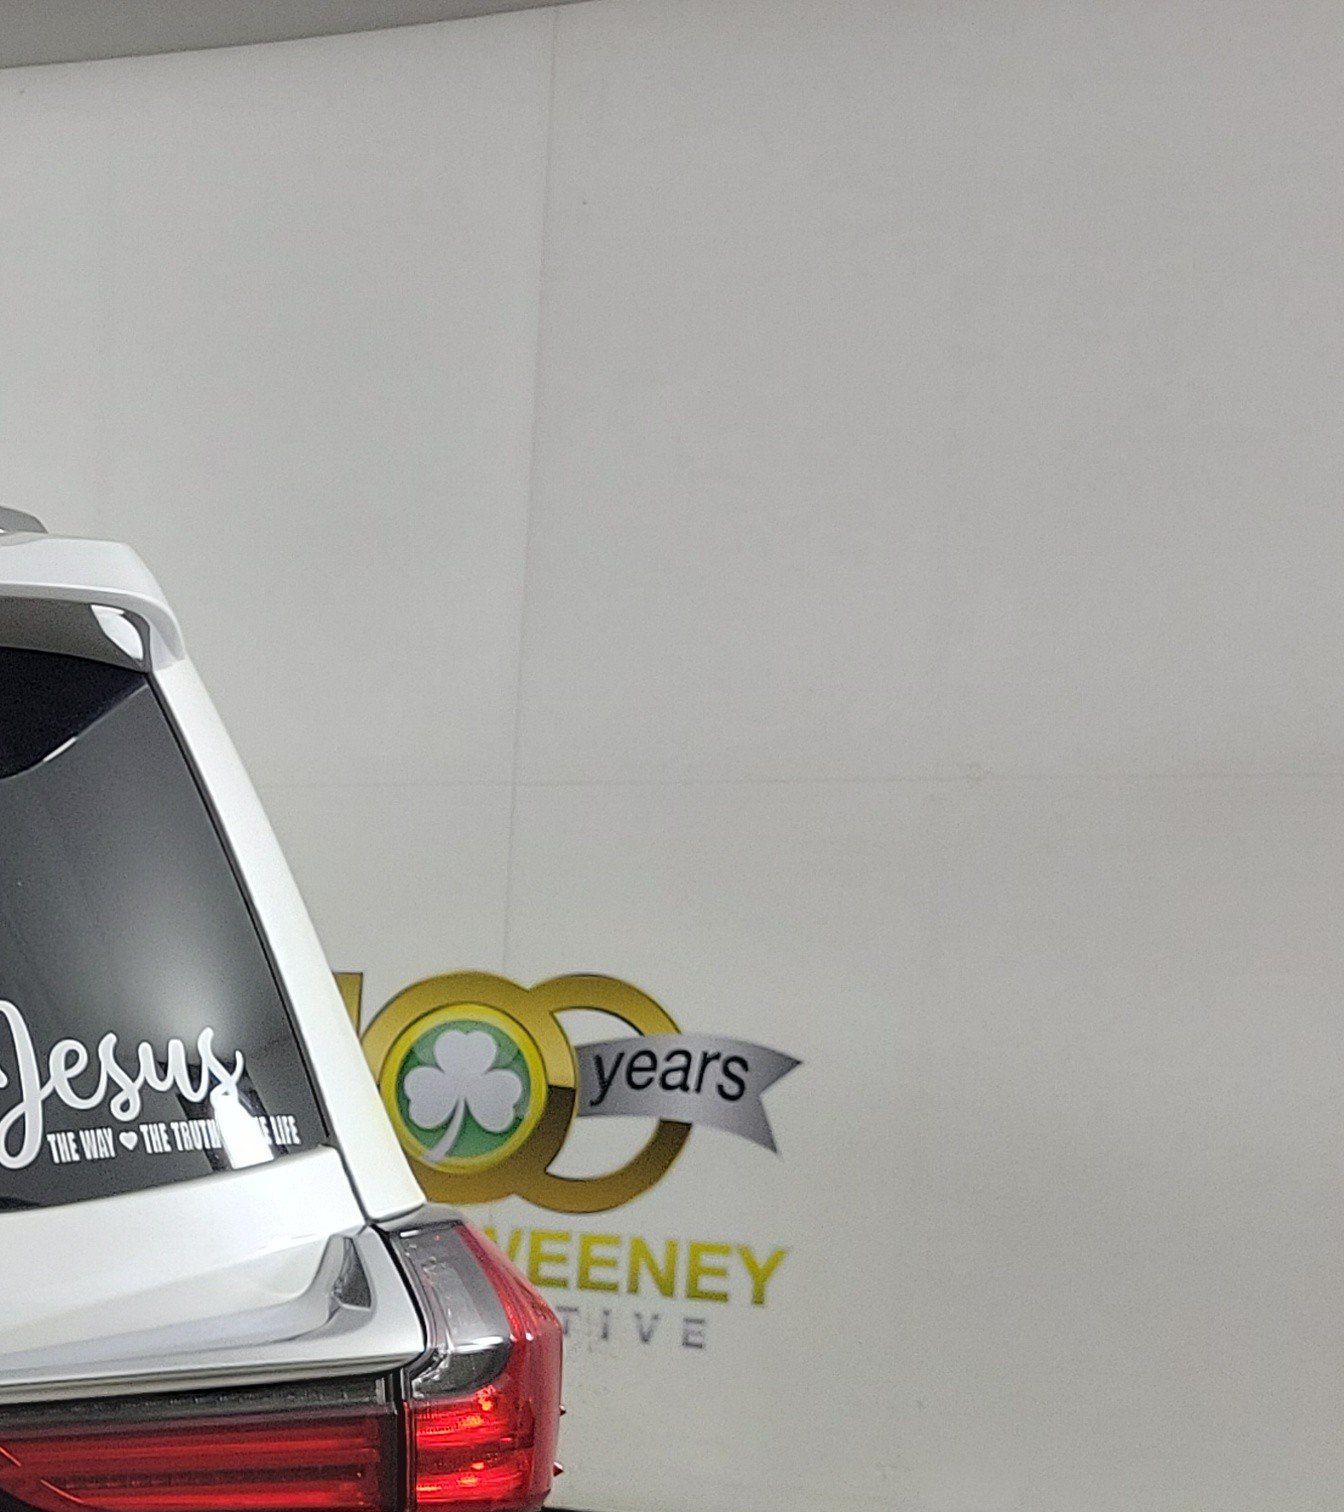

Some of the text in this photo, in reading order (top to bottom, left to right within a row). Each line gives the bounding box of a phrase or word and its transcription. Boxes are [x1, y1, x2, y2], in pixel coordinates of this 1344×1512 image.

[333, 971, 692, 1214] 00
[588, 1048, 750, 1108] years
[47, 1132, 81, 1164] THE
[79, 1127, 116, 1161] WAY
[139, 1121, 171, 1154] THE
[269, 1114, 302, 1146] LIFE
